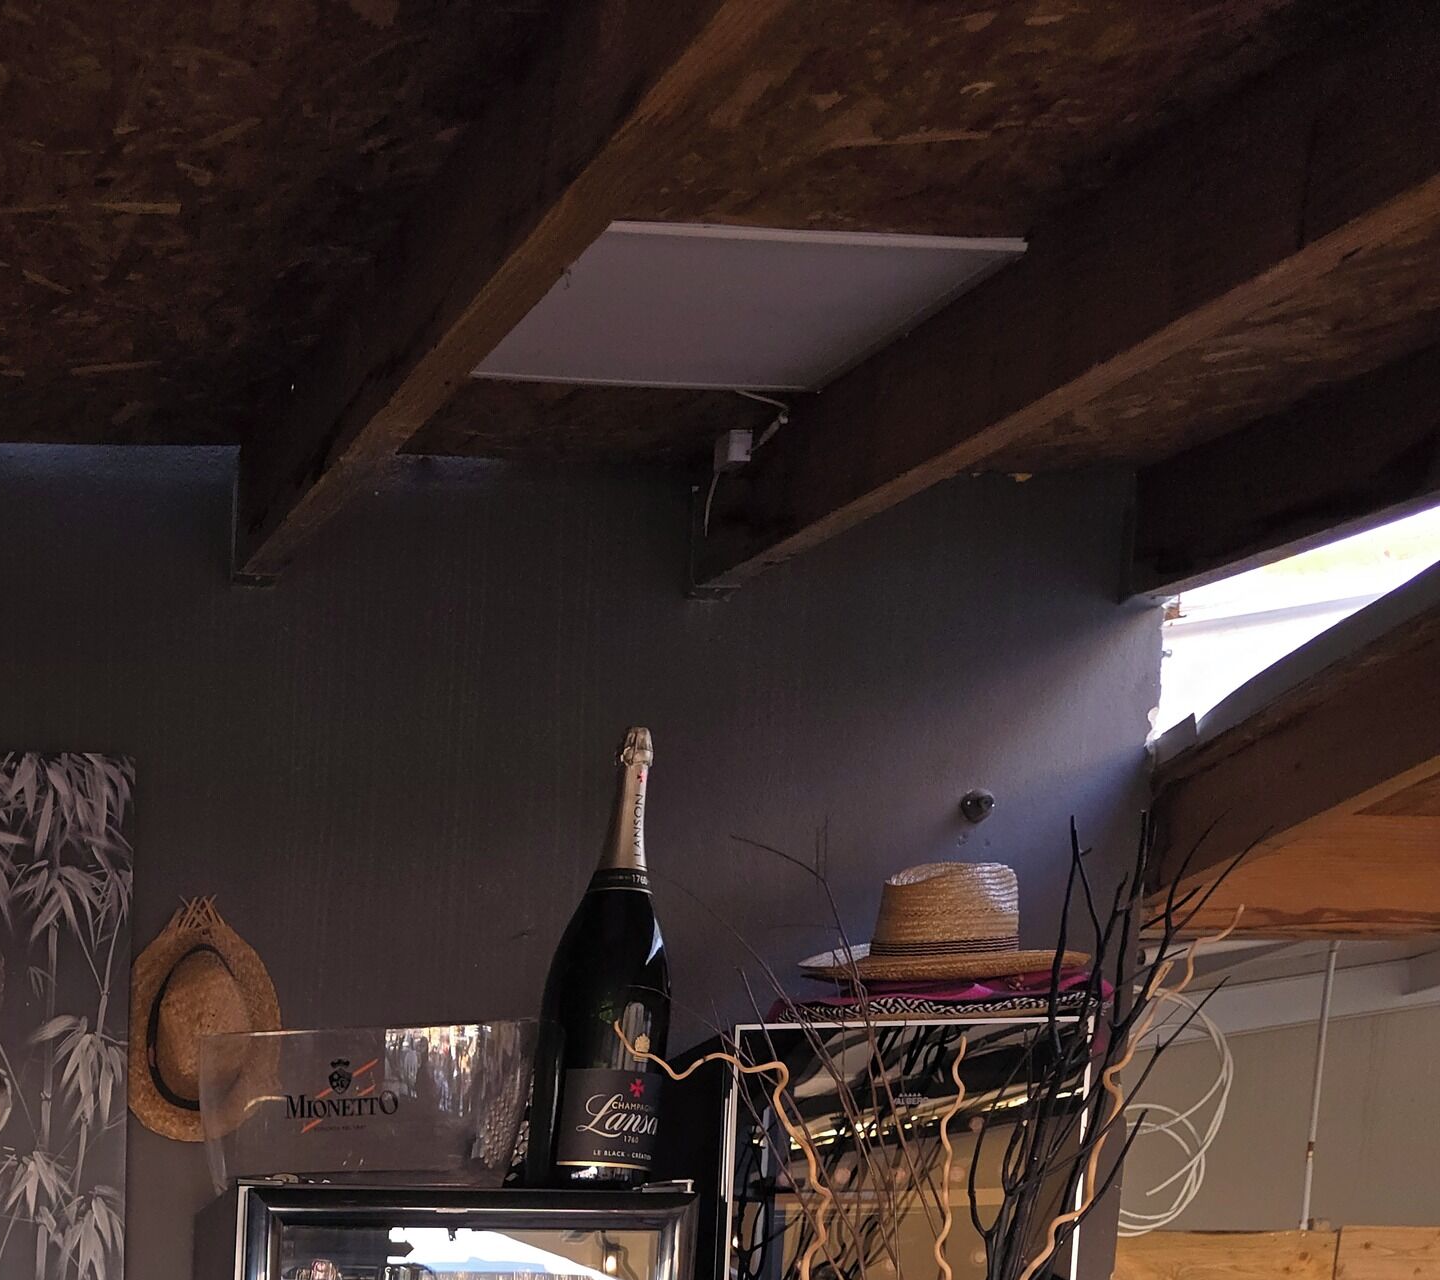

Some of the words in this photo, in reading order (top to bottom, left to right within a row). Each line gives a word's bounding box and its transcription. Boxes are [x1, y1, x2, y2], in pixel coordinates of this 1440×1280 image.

[633, 793, 644, 857] LANSON
[283, 1090, 399, 1120] MIONETTO
[623, 1135, 640, 1144] 1760
[593, 1149, 601, 1157] LE
[604, 1150, 625, 1158] BLACK
